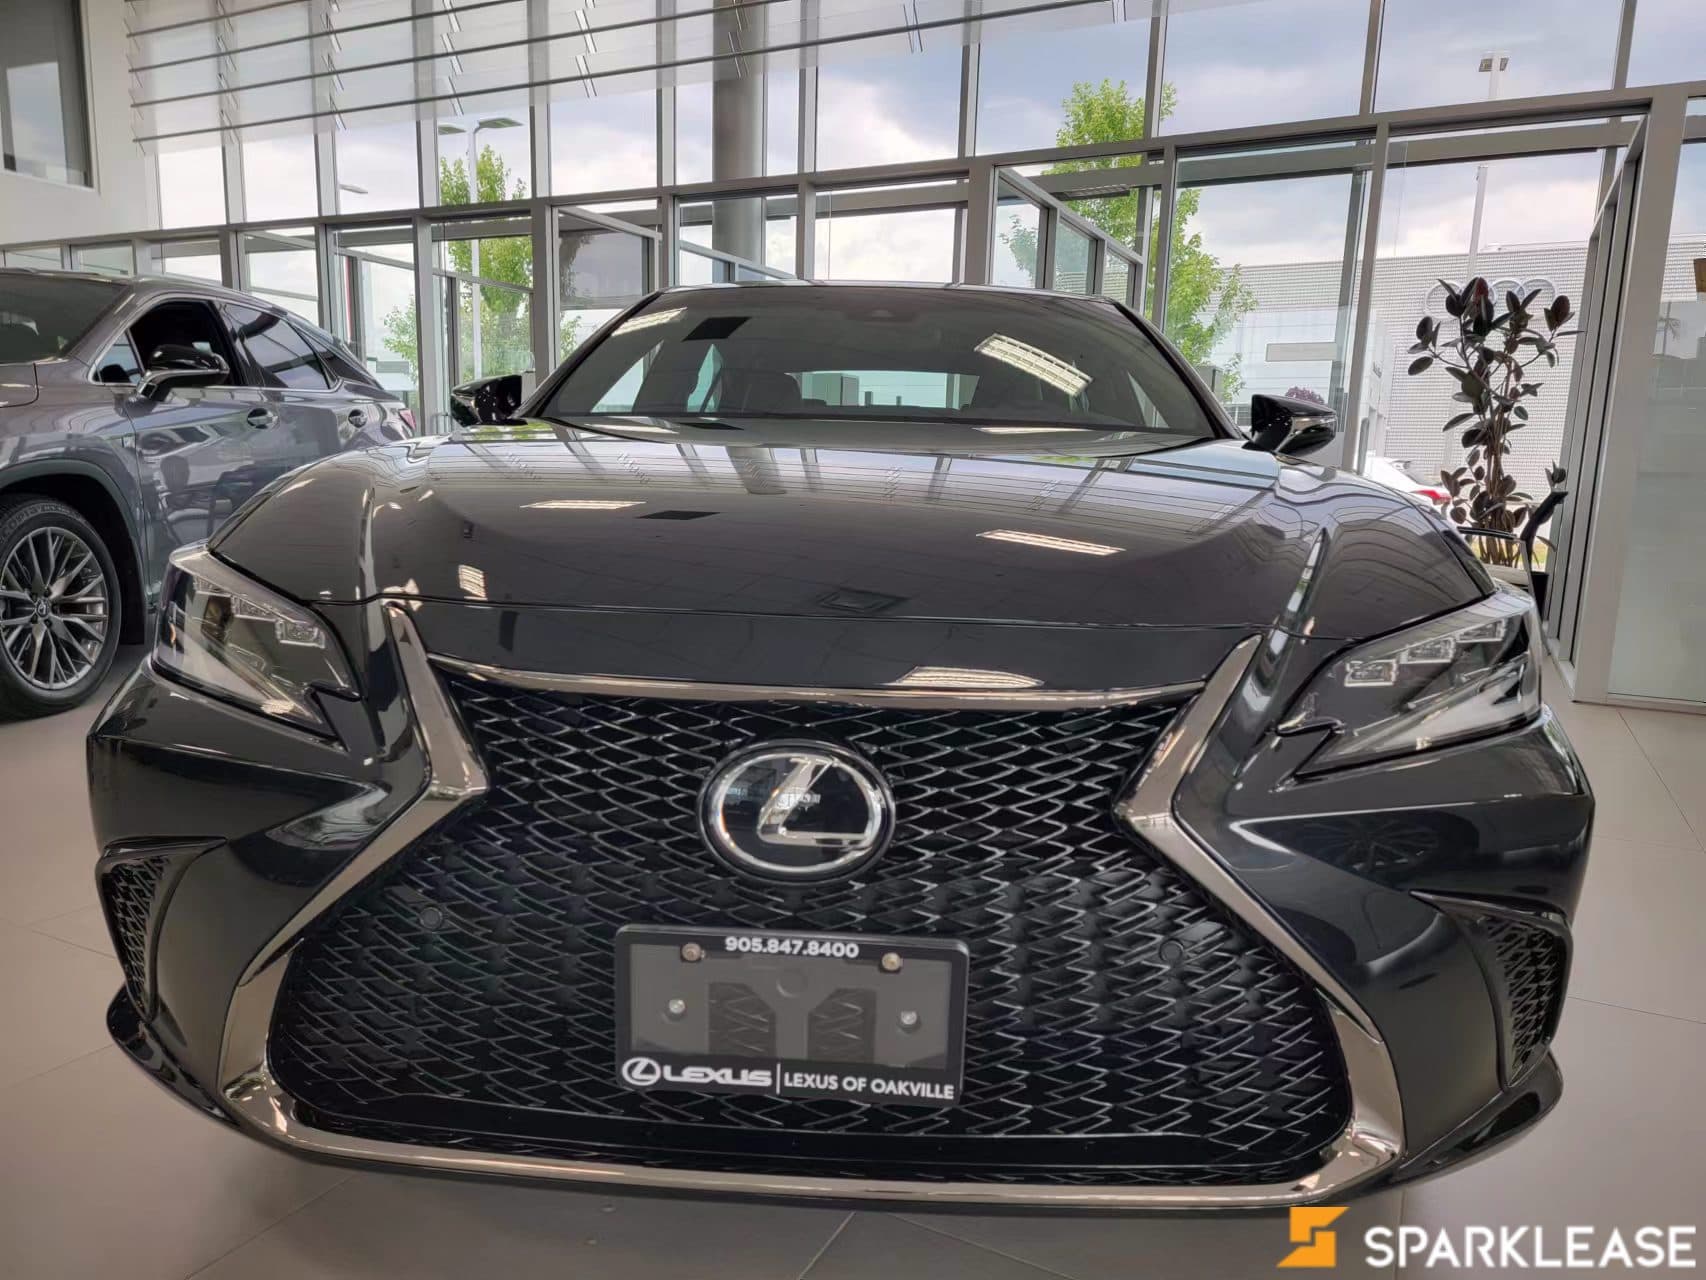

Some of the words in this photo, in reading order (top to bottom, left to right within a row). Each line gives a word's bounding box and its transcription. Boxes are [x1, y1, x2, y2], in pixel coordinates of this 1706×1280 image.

[725, 936, 860, 958] 905.847.8400
[662, 1065, 773, 1087] LEXUS
[784, 1072, 838, 1091] LEXUS
[842, 1075, 868, 1092] OF
[871, 1078, 955, 1100] OAKVILLE
